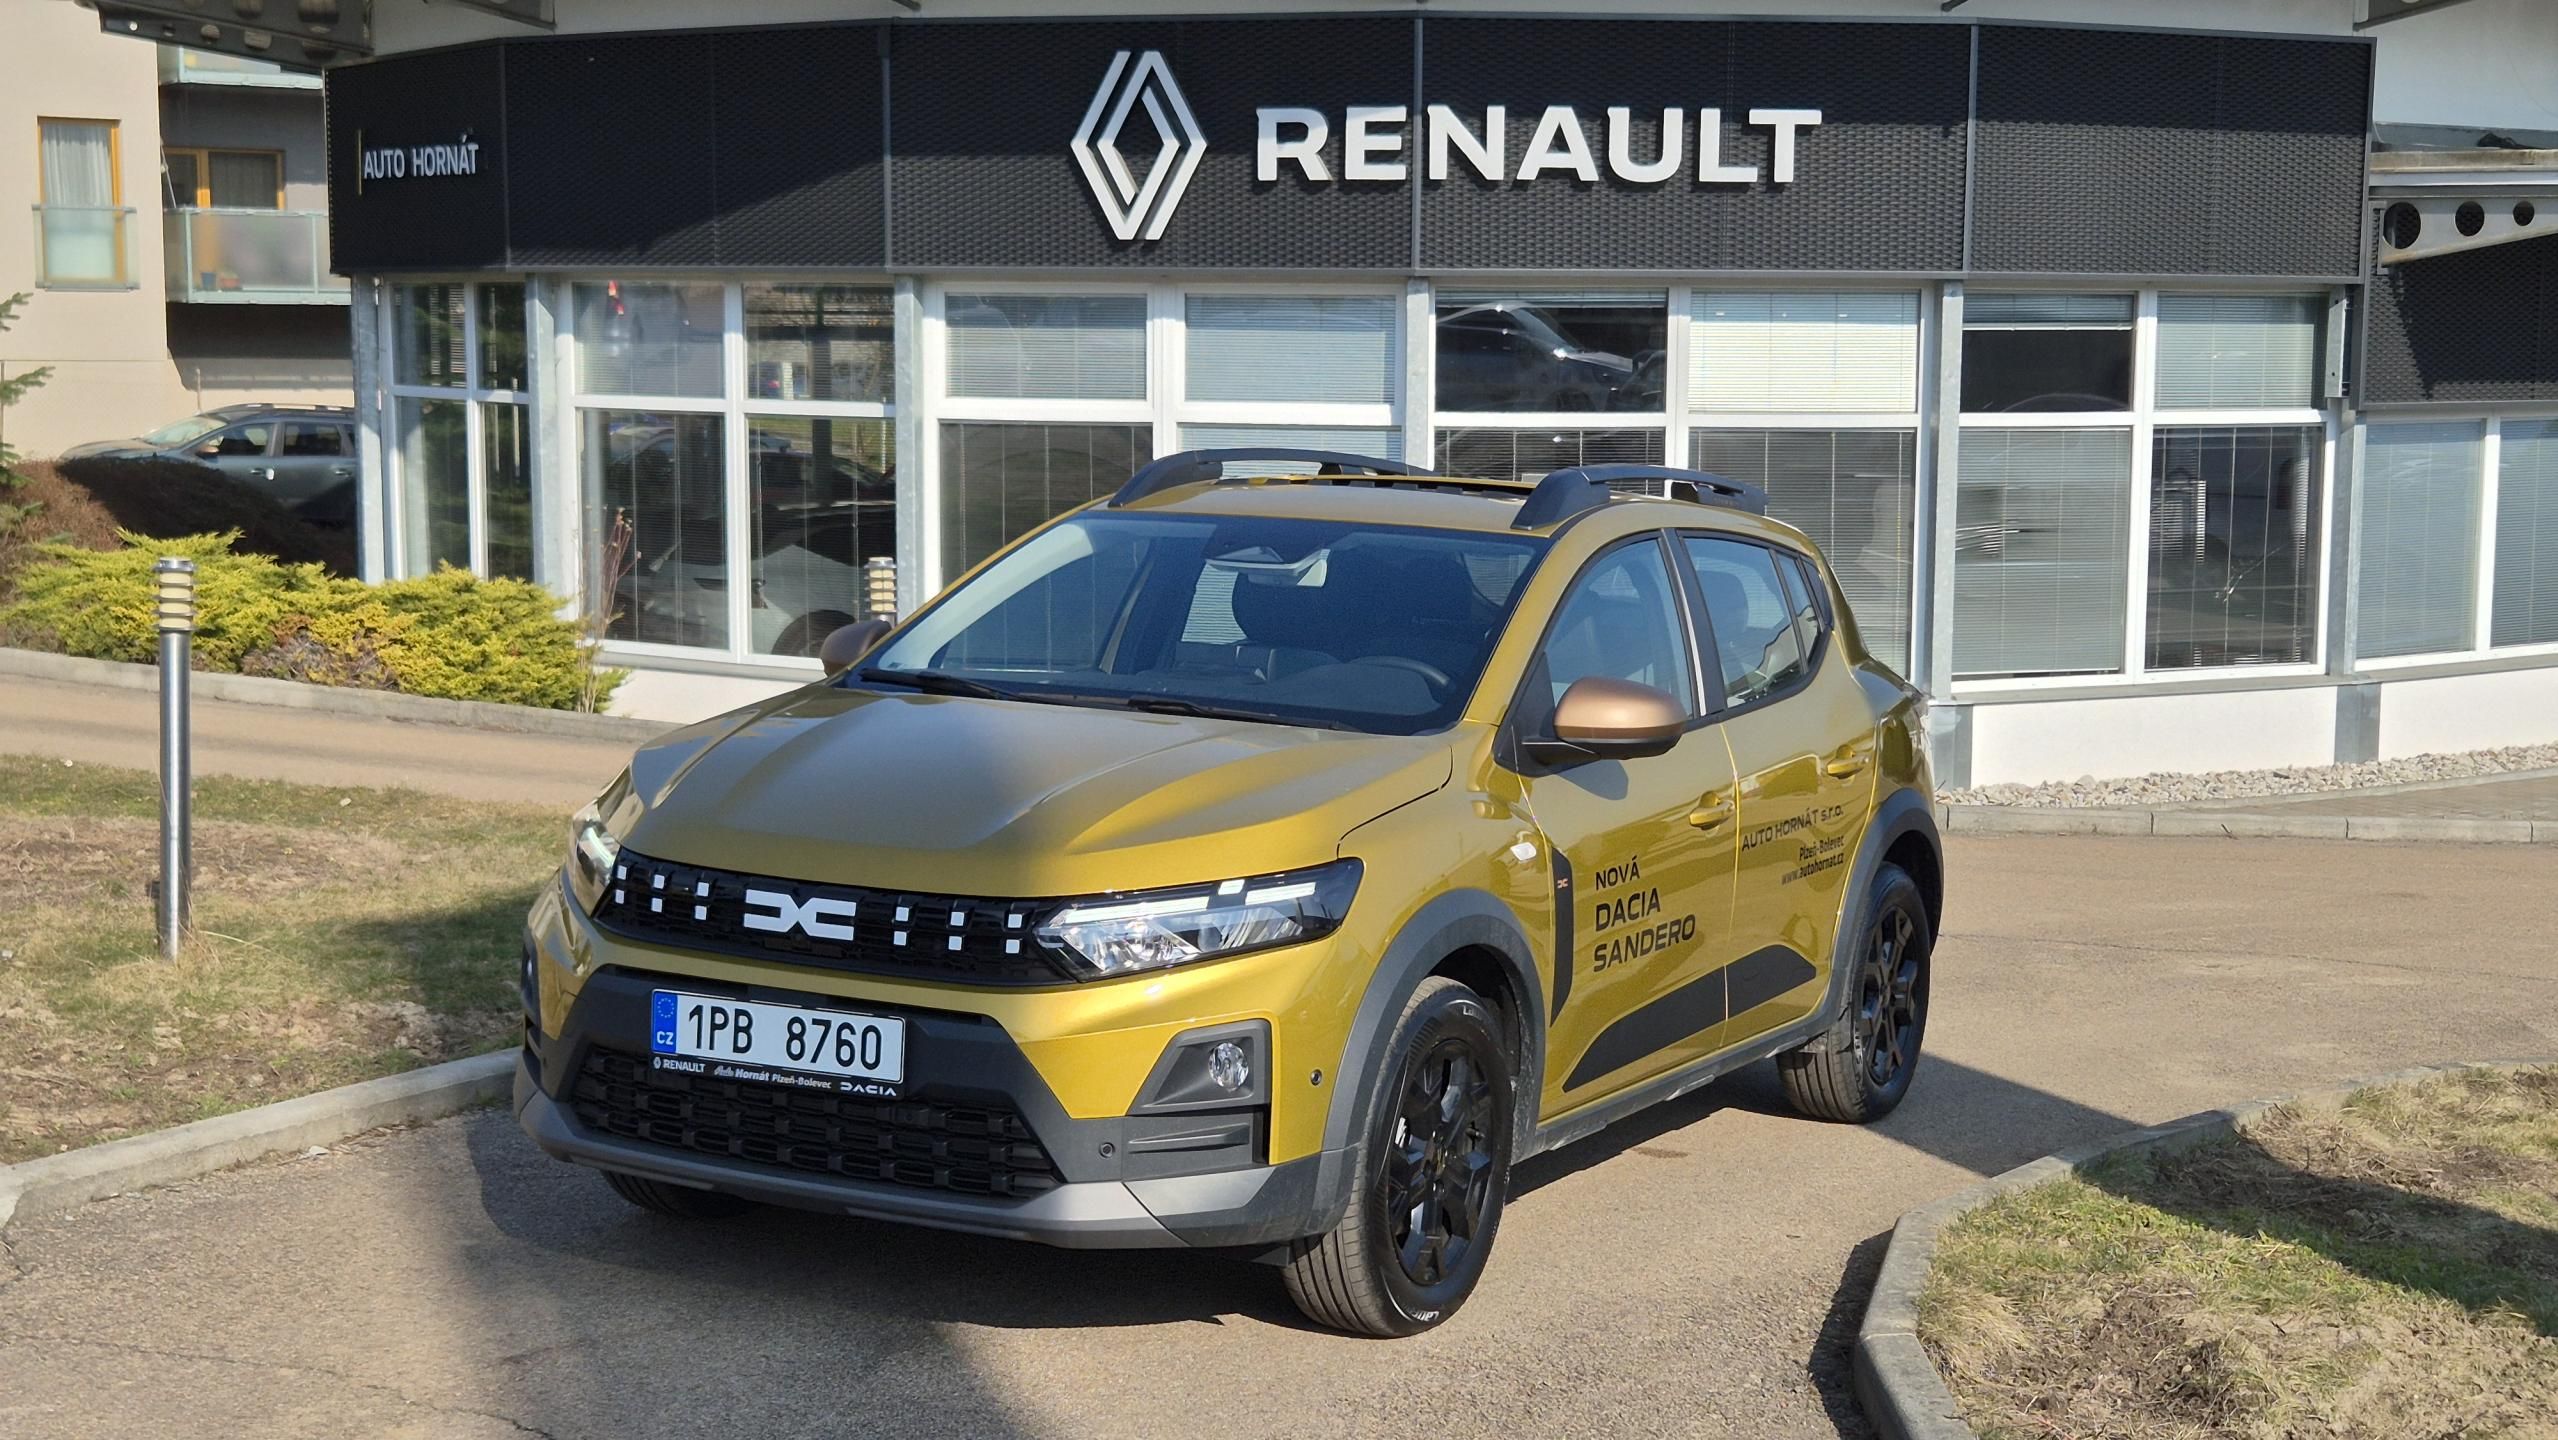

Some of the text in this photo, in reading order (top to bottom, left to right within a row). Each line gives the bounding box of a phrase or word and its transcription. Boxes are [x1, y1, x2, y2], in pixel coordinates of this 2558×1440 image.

[363, 133, 479, 179] AUTO HORNÁT
[1256, 105, 1822, 183] RENAULT
[1742, 805, 1844, 852] AUTO HORNÁT s.r.o.
[1595, 856, 1641, 891] NOVÁ
[1781, 853, 1844, 885] www.autohornat.cz
[1595, 887, 1661, 932] DACIA
[1593, 914, 1696, 973] SANDERO
[656, 1031, 674, 1045] CZ
[688, 1004, 882, 1070] 1PB 8760
[663, 1059, 706, 1073] RENAULT
[735, 1068, 770, 1081] Hornát
[772, 1073, 832, 1089] Plzeň-Bolevec
[840, 1081, 897, 1096] DACIA
